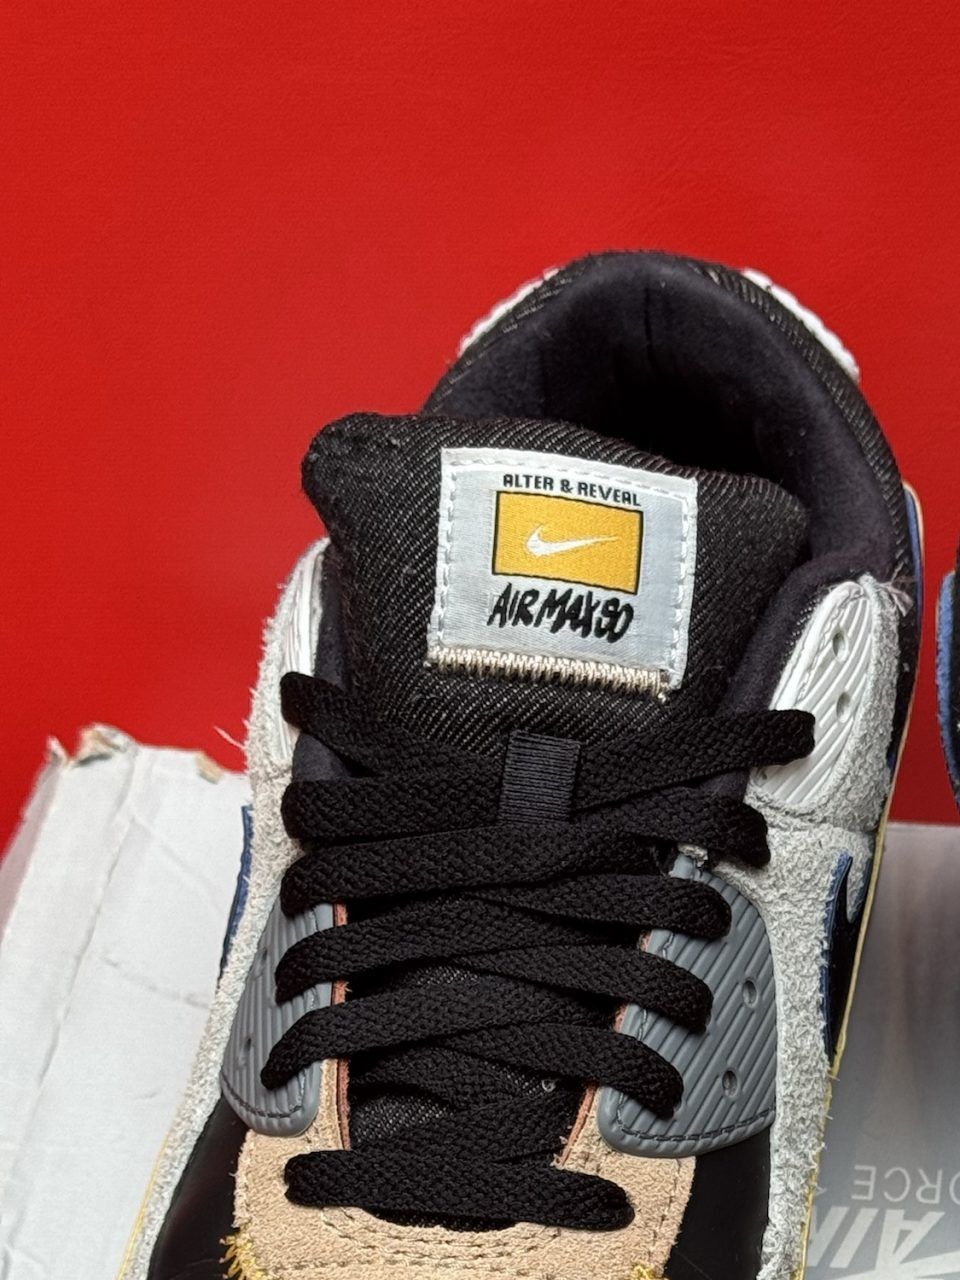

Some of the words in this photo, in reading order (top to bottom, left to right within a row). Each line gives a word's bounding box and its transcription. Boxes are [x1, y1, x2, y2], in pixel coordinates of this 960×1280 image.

[503, 473, 554, 490] ALTER
[560, 478, 573, 492] &
[577, 482, 640, 506] REVEAL
